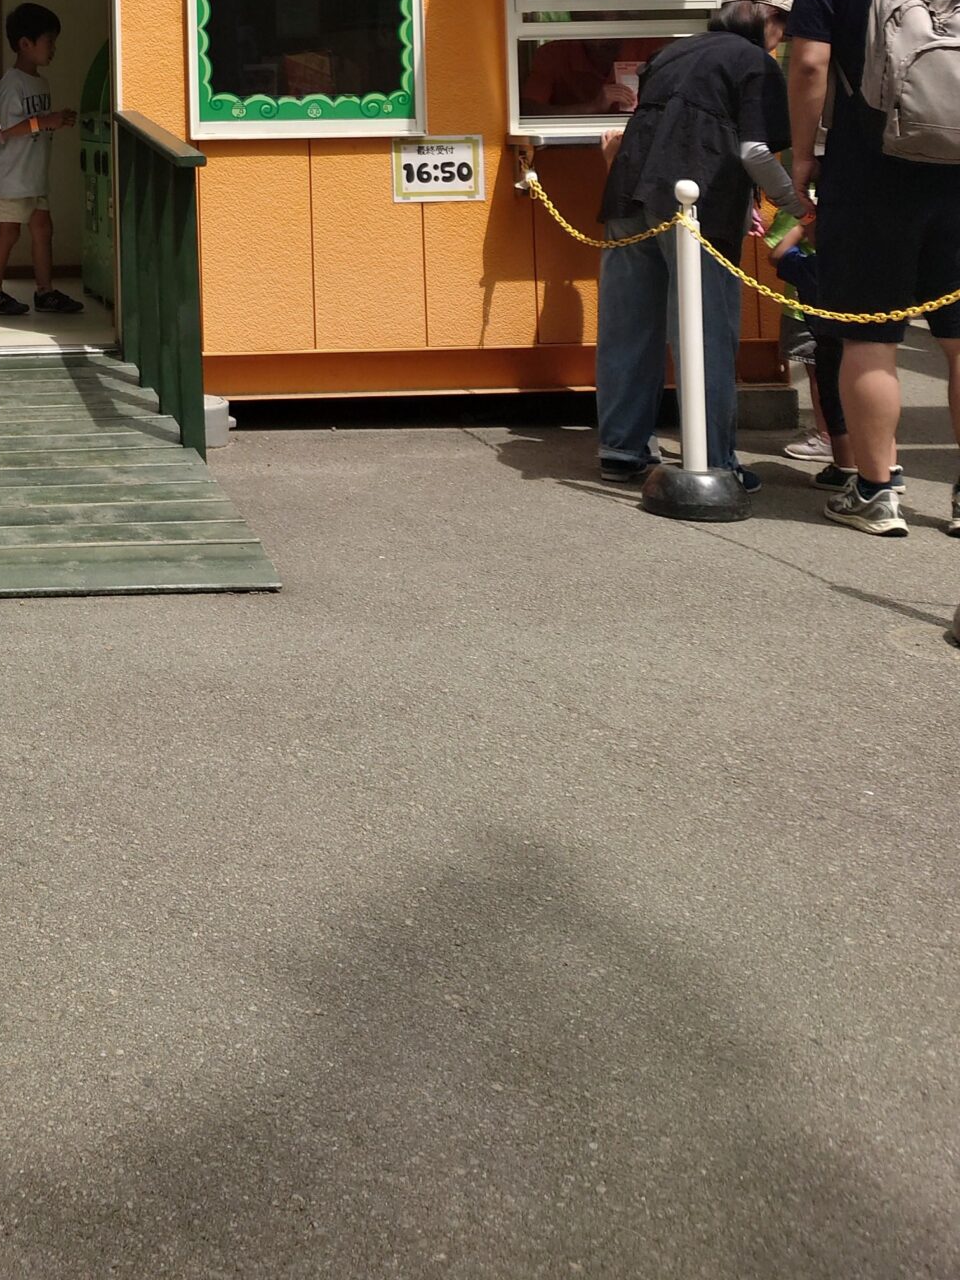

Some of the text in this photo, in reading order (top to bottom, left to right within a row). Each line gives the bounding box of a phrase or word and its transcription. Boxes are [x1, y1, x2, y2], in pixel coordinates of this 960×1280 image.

[417, 145, 455, 156] 最終受付
[402, 161, 473, 184] 16:50
